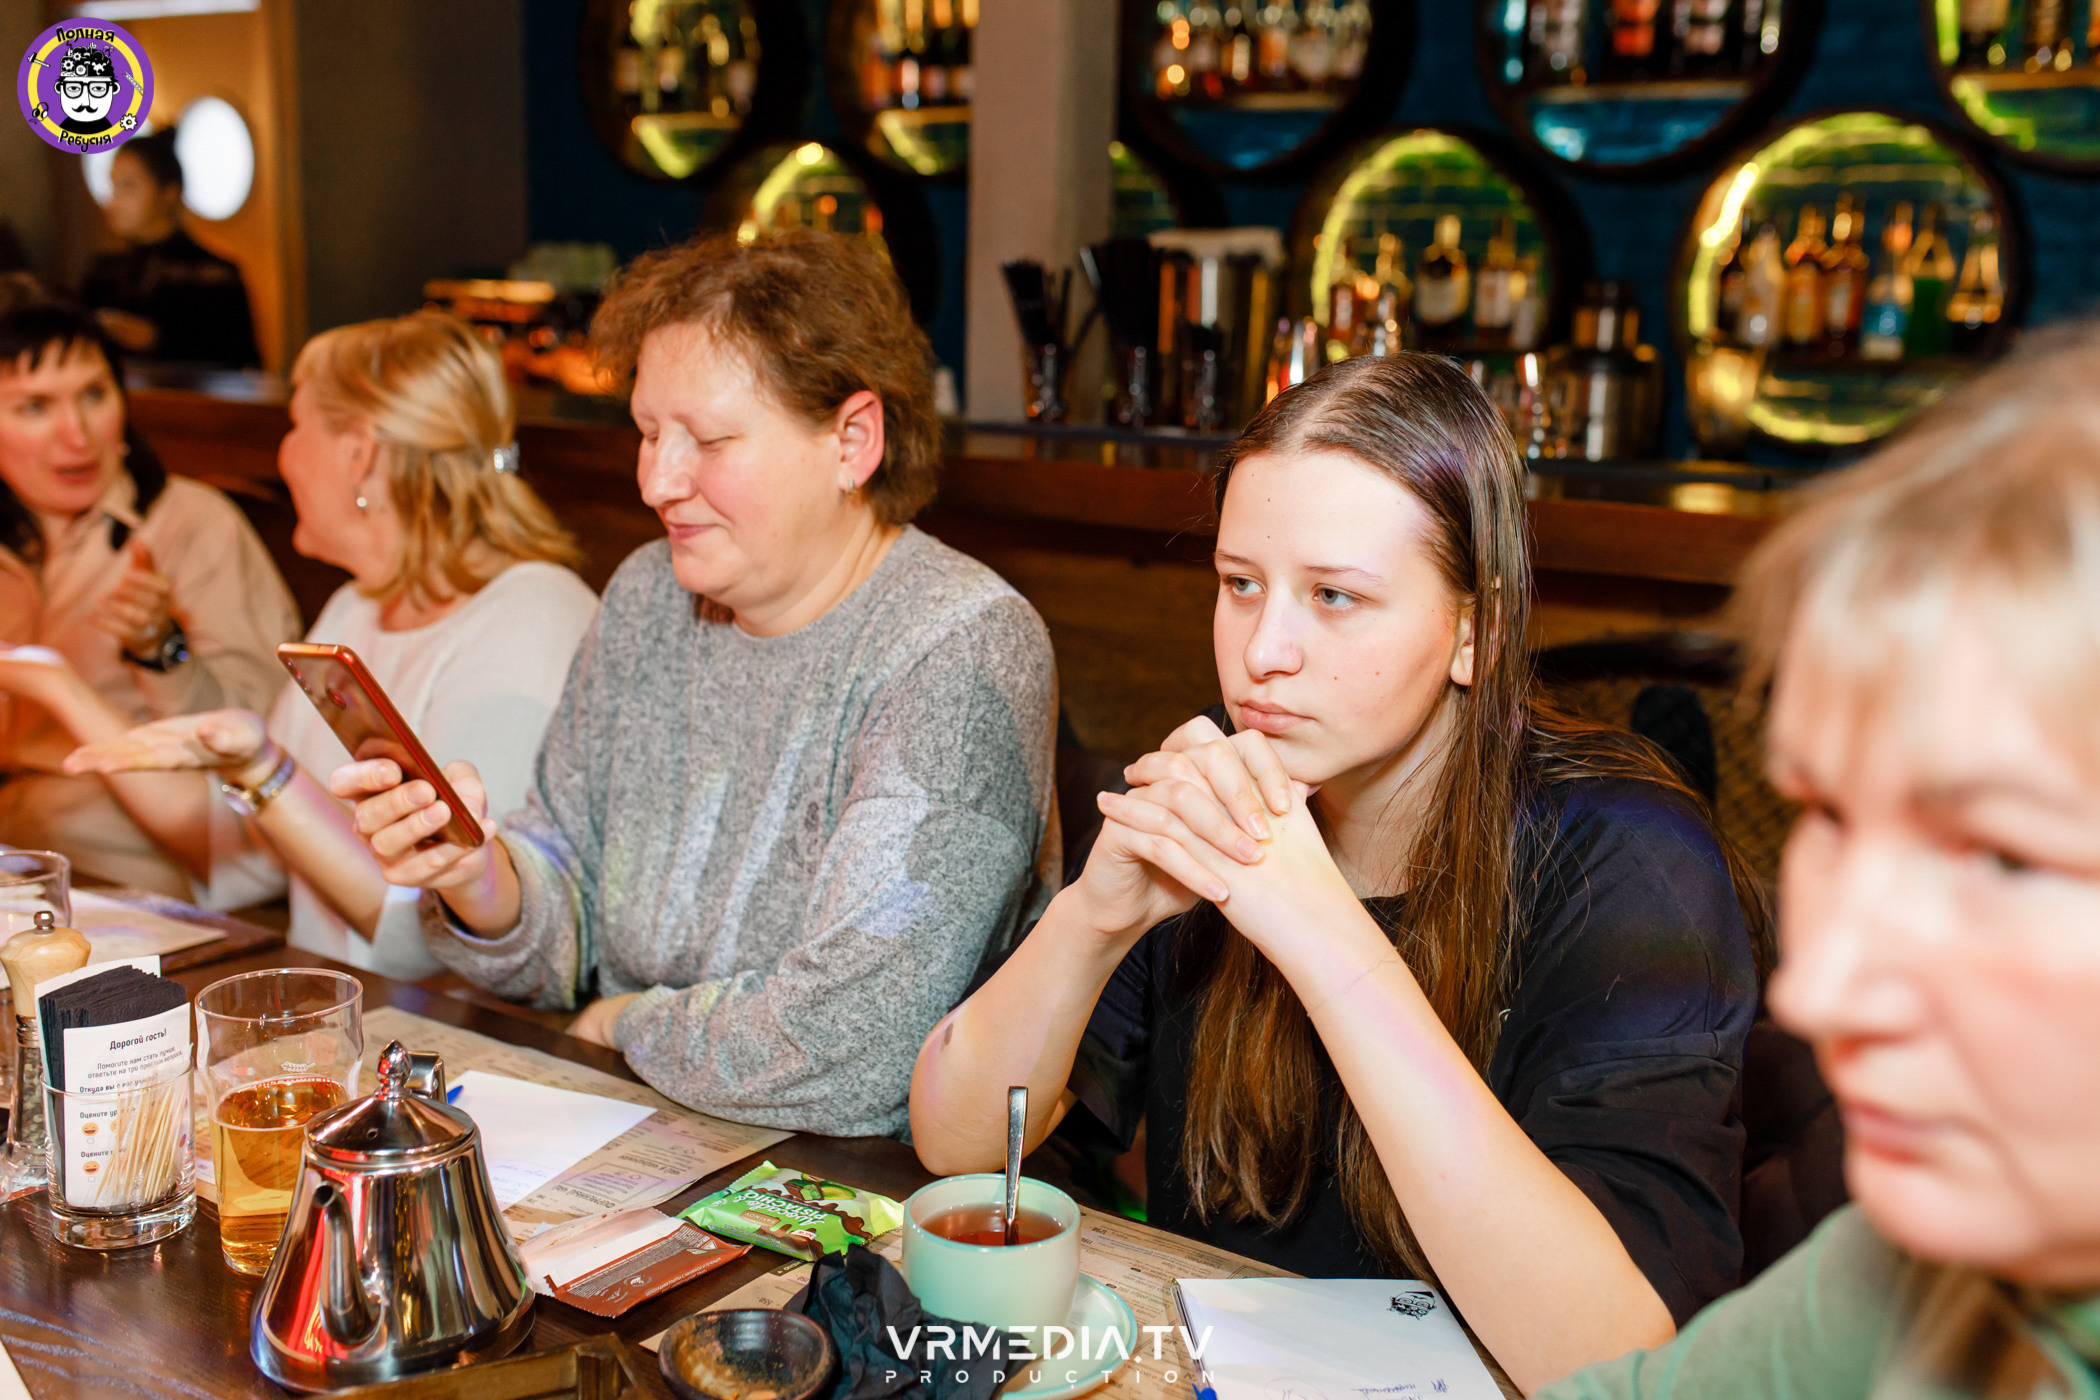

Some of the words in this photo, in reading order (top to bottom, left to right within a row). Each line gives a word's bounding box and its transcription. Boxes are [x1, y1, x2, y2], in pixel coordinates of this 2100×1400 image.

[110, 1035, 144, 1050] Дорогой
[146, 1028, 167, 1042] гость!
[97, 1060, 128, 1070] Помогите
[143, 1052, 158, 1062] стать
[88, 1070, 117, 1078] ответьте
[128, 1065, 138, 1074] три
[80, 1086, 104, 1094] Откуда
[80, 1111, 108, 1119] Оцените
[80, 1150, 108, 1158] Оцените
[744, 1189, 828, 1220] PISTACHIO
[747, 1201, 826, 1226] Avocado
[797, 1230, 814, 1238] NEW
